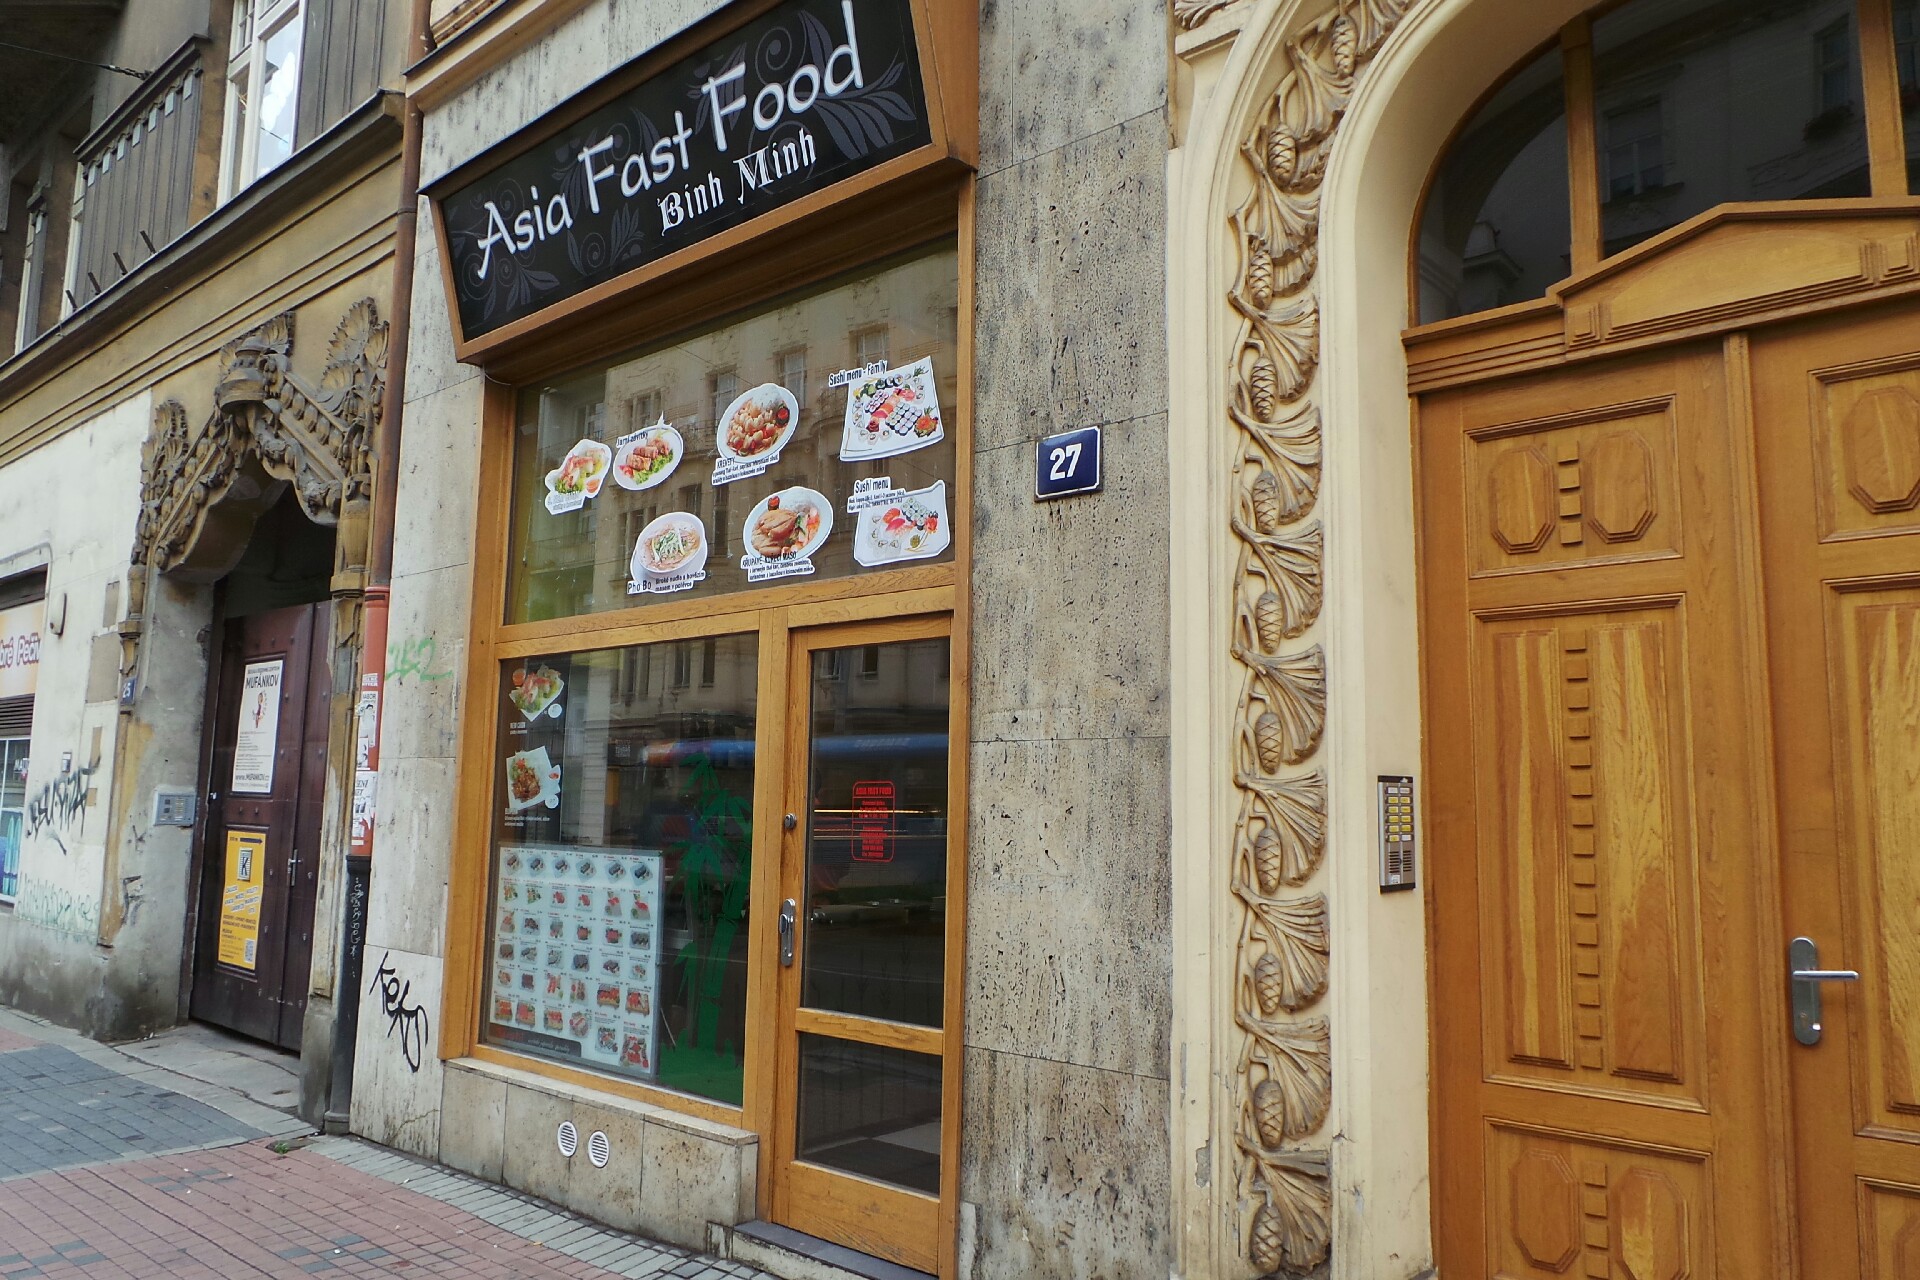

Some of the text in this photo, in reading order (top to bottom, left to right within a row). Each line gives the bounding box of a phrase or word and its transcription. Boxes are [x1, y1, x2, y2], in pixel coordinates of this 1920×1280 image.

[476, 0, 864, 280] Asia Fast Food
[658, 128, 817, 237] Binh Minh
[830, 371, 845, 386] Sushi
[847, 368, 862, 382] menu
[868, 360, 887, 376] Family
[1050, 443, 1081, 480] 27
[855, 480, 888, 494] Sushi menu
[626, 580, 652, 593] Pho Bo
[246, 671, 279, 690] MUFÁNKOV
